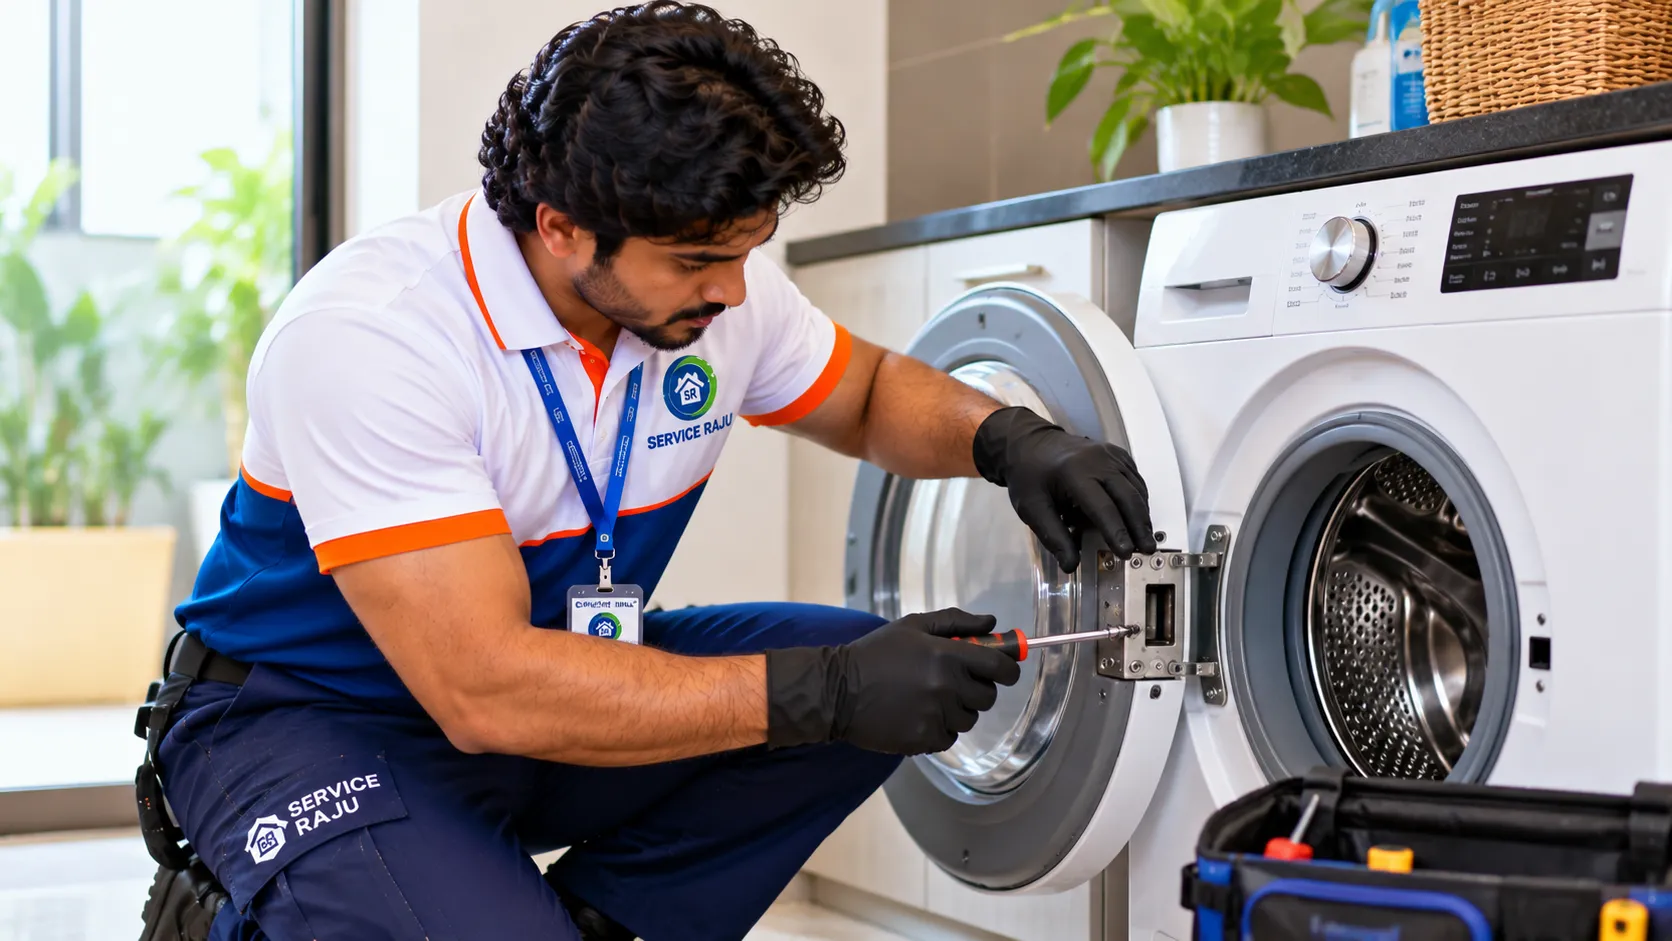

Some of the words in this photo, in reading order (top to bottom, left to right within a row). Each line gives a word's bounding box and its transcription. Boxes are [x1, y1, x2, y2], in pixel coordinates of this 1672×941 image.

[684, 387, 698, 401] SR
[647, 425, 701, 450] SERVICE
[703, 412, 734, 435] RAJU
[288, 774, 380, 817] SERVICE
[295, 797, 359, 836] RAJU
